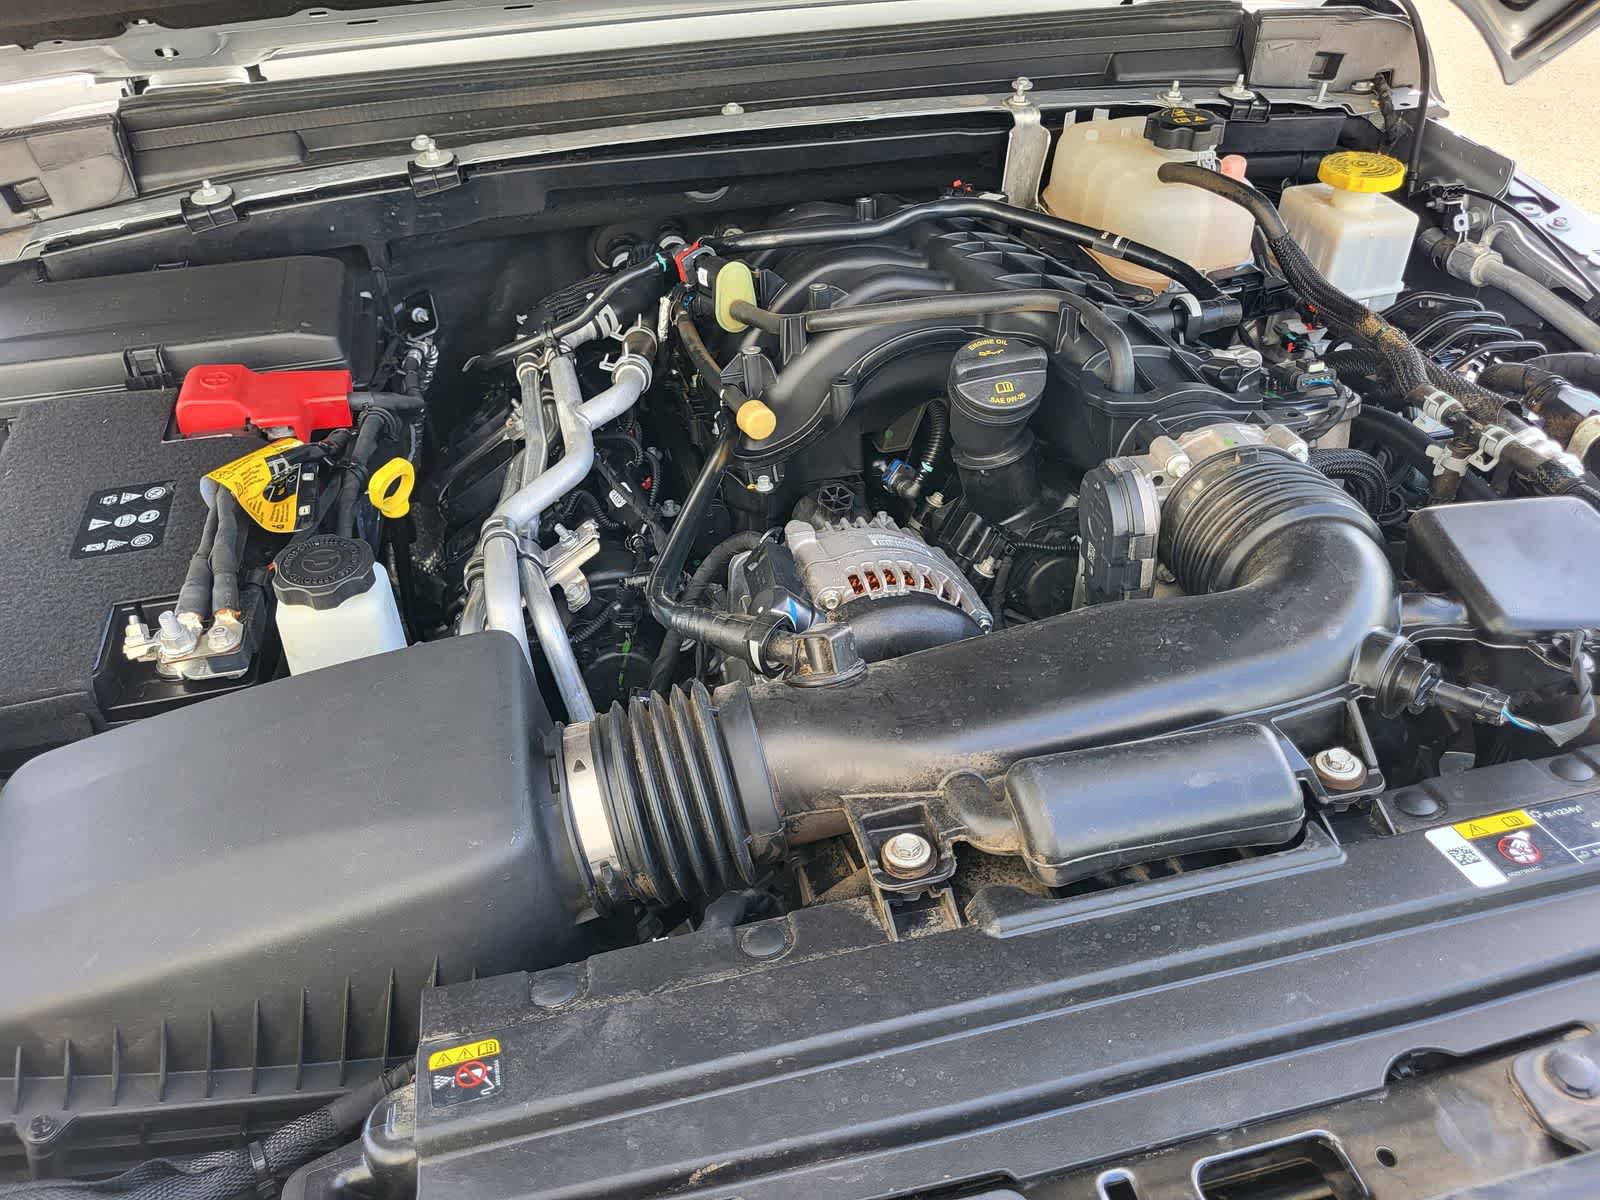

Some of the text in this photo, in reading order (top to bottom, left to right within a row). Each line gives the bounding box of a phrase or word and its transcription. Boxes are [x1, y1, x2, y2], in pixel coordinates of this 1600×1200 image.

[967, 338, 1008, 351] ENGINE OIL
[990, 396, 1006, 404] SAE
